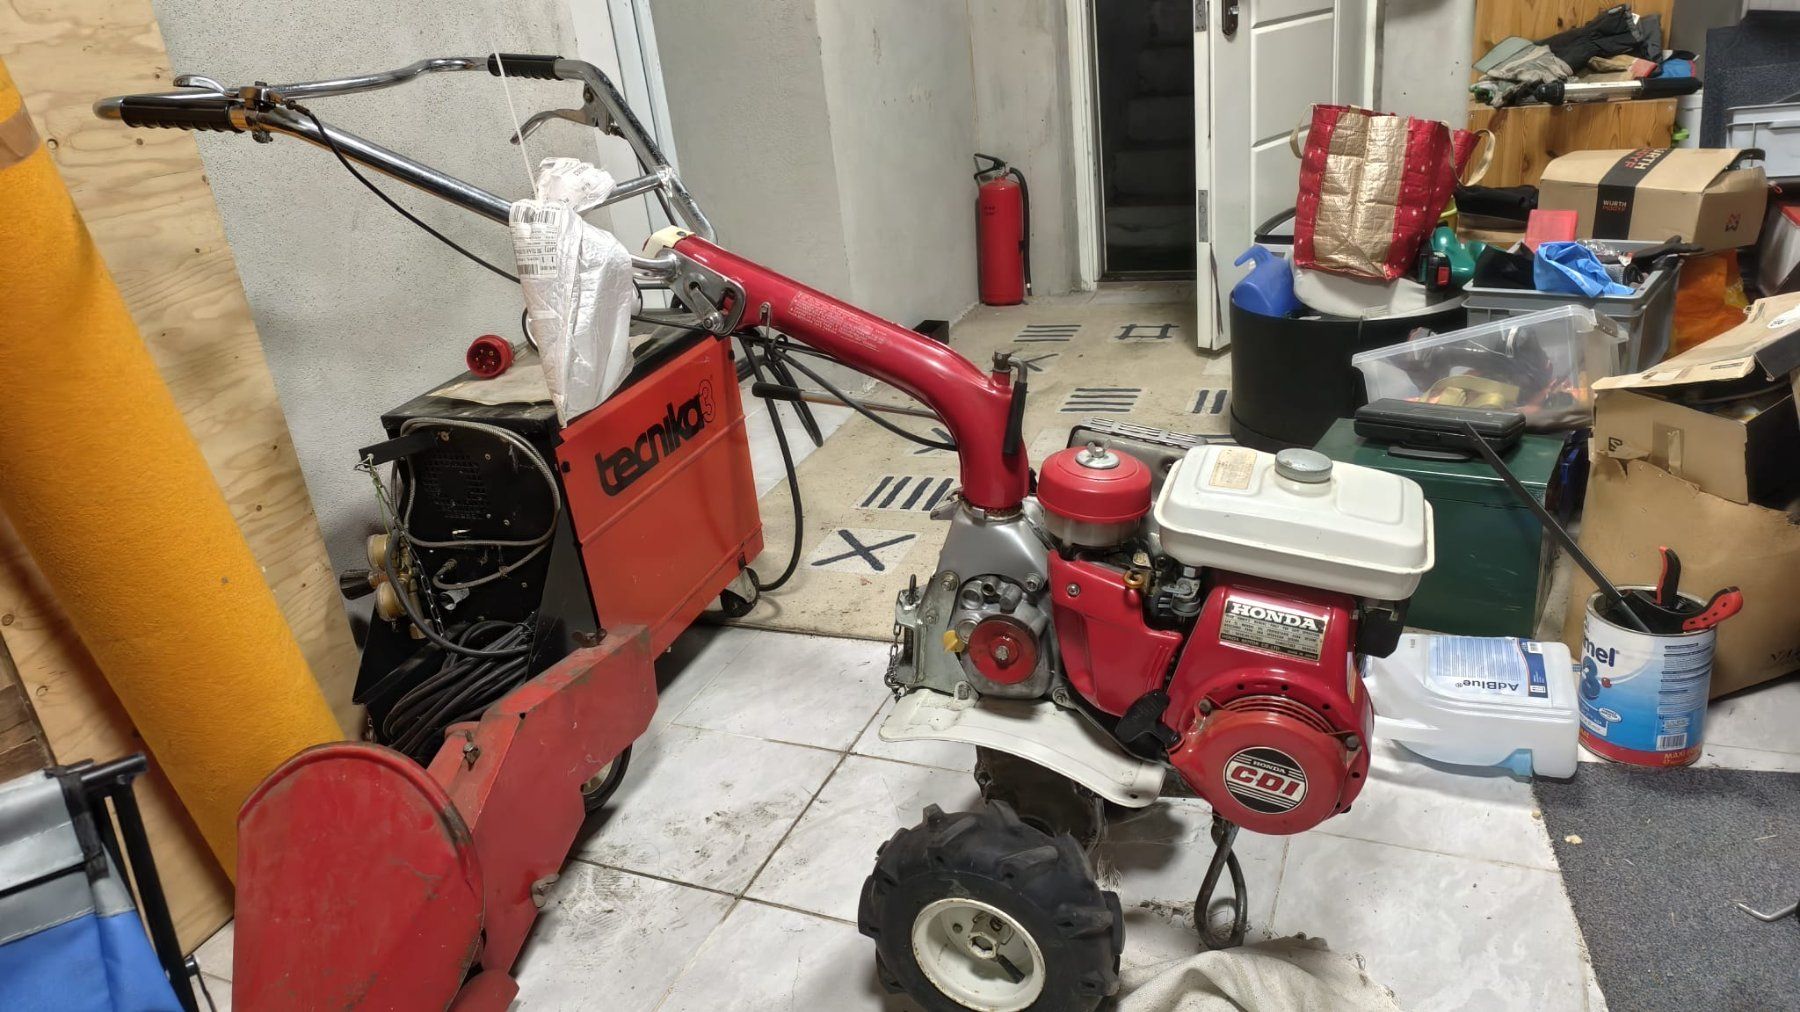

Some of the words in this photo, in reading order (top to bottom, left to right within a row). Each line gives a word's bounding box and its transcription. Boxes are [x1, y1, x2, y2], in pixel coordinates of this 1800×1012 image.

[595, 391, 705, 497] tecnika
[1231, 602, 1319, 632] HONDA
[1230, 765, 1301, 797] CDI
[1252, 760, 1287, 775] HONDA
